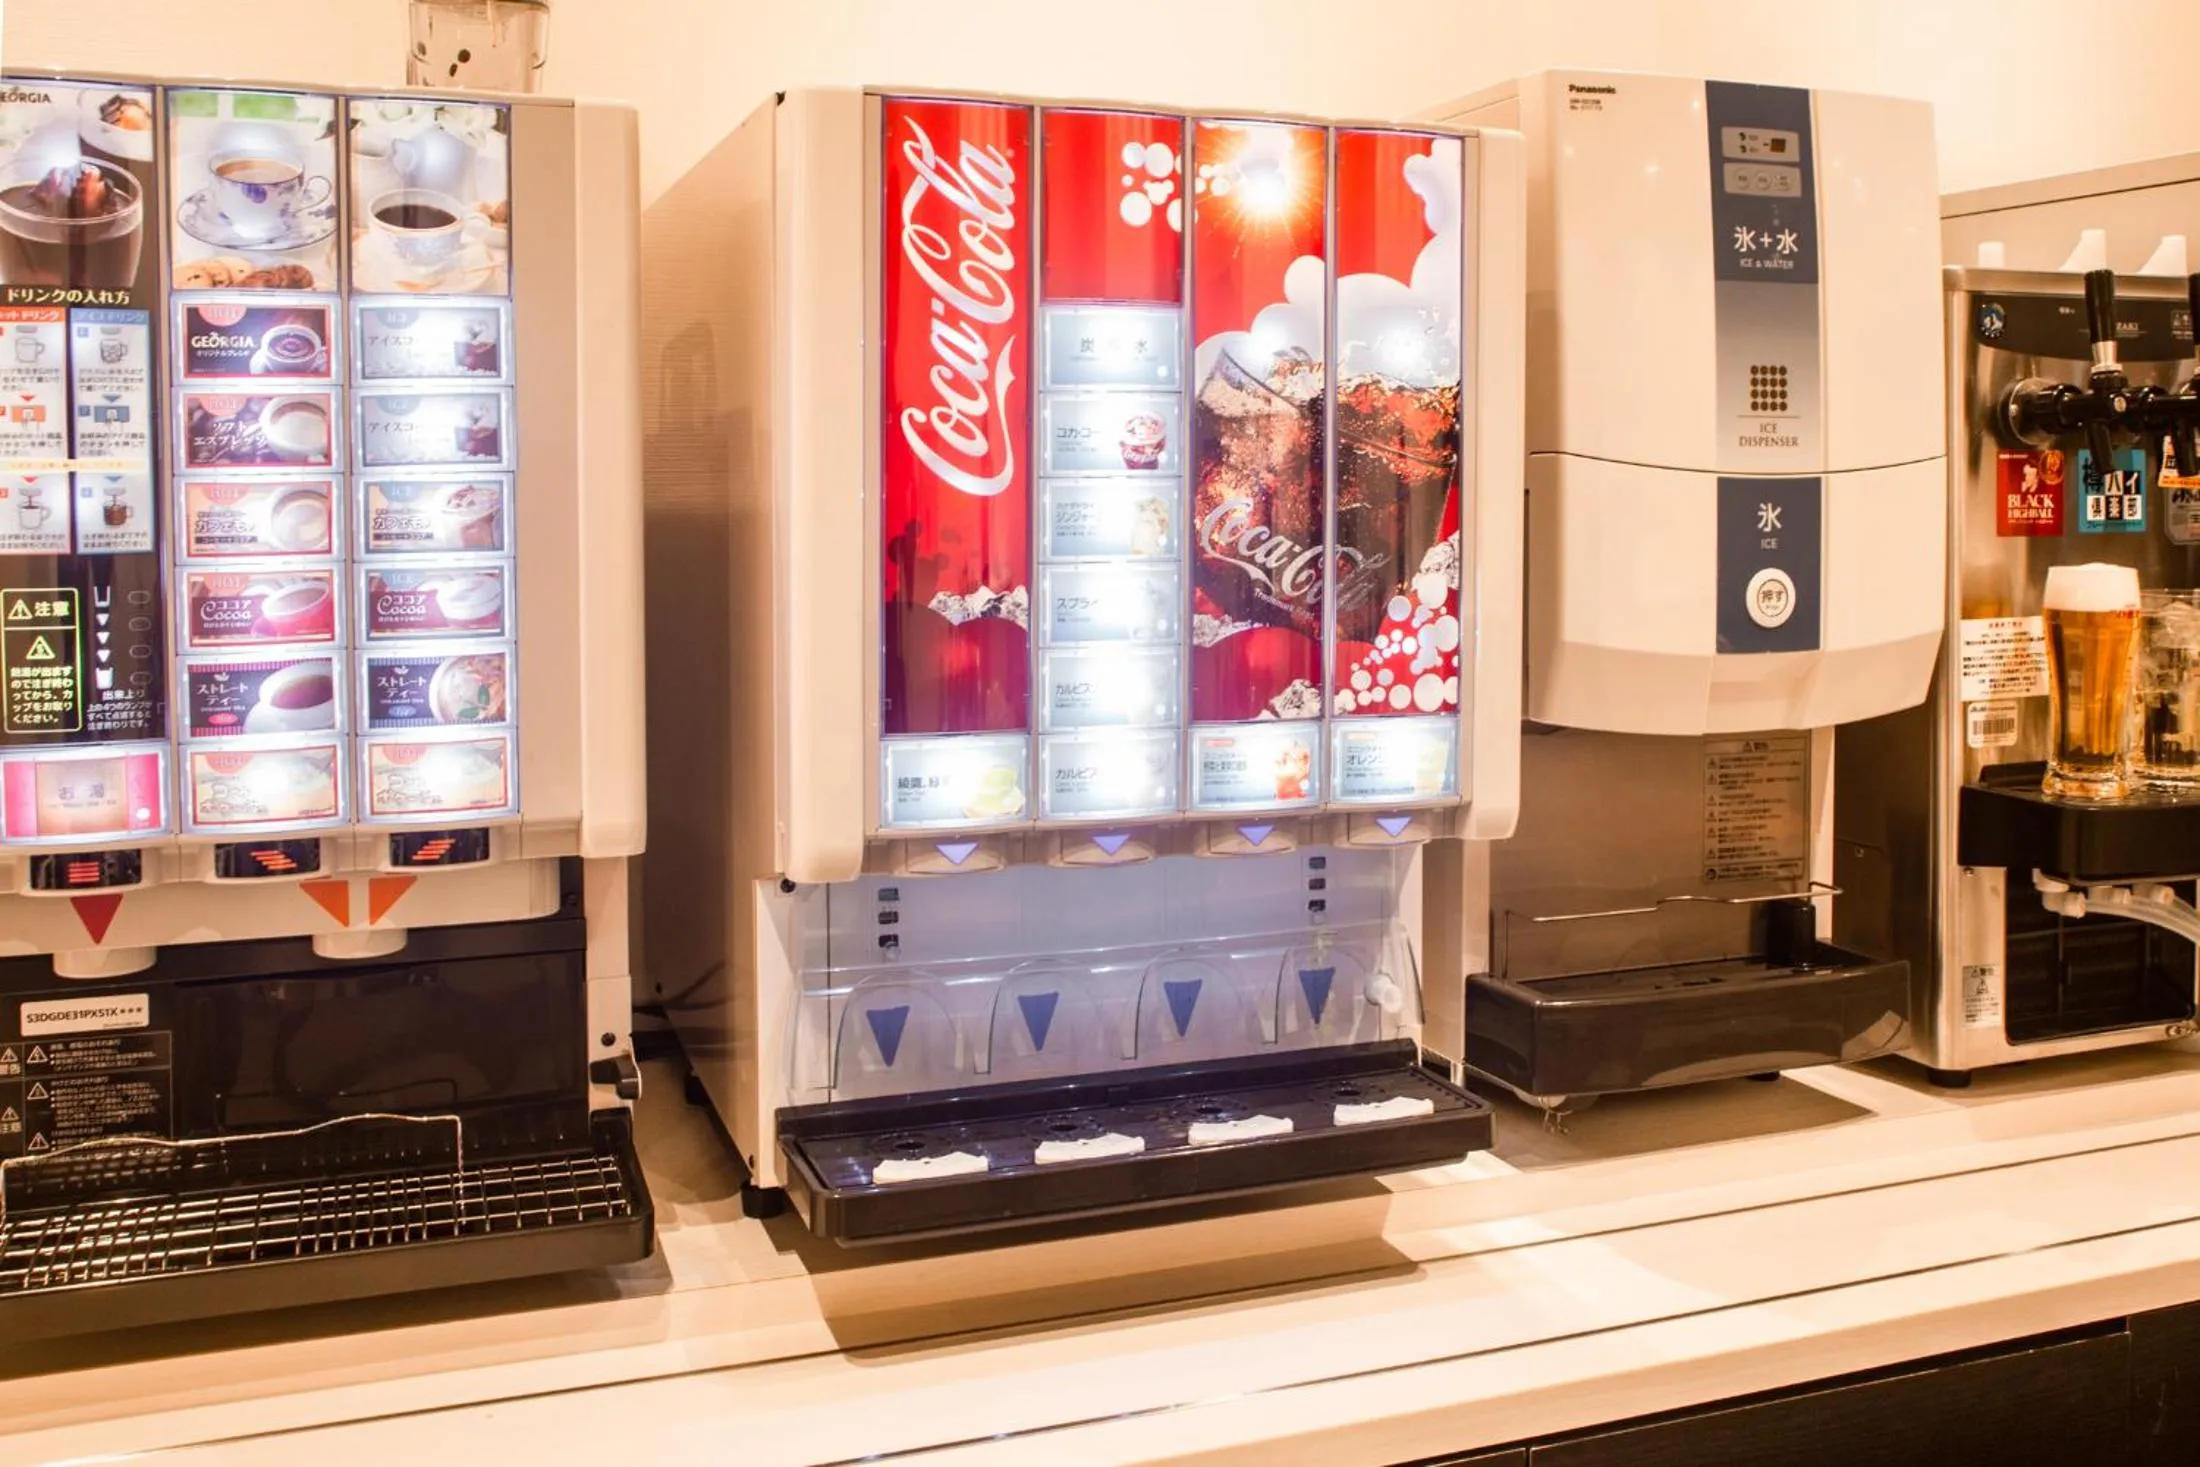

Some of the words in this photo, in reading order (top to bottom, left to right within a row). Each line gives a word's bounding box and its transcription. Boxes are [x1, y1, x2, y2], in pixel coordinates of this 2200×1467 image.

[1569, 84, 1616, 95] Panasonic
[0, 91, 51, 103] EORGIA
[1740, 258, 1753, 268] ICE
[1763, 259, 1794, 270] WATER
[8, 289, 130, 304] ドリンクの入れ方
[901, 115, 1015, 496] Coca-Cola
[1760, 423, 1778, 434] ICE
[1739, 435, 1799, 448] DISPENSER
[2007, 494, 2055, 509] BLACK
[1757, 503, 1783, 533] 氷
[1760, 538, 1778, 550] ICE
[1761, 589, 1785, 603] 押す
[35, 601, 70, 617] 注意
[201, 601, 251, 621] Cocoa
[377, 595, 427, 615] Cocoa
[377, 676, 427, 687] ストレート
[196, 682, 249, 695] ストレート
[384, 688, 420, 699] ティー
[206, 694, 241, 706] ティー
[13, 713, 60, 725] ください。
